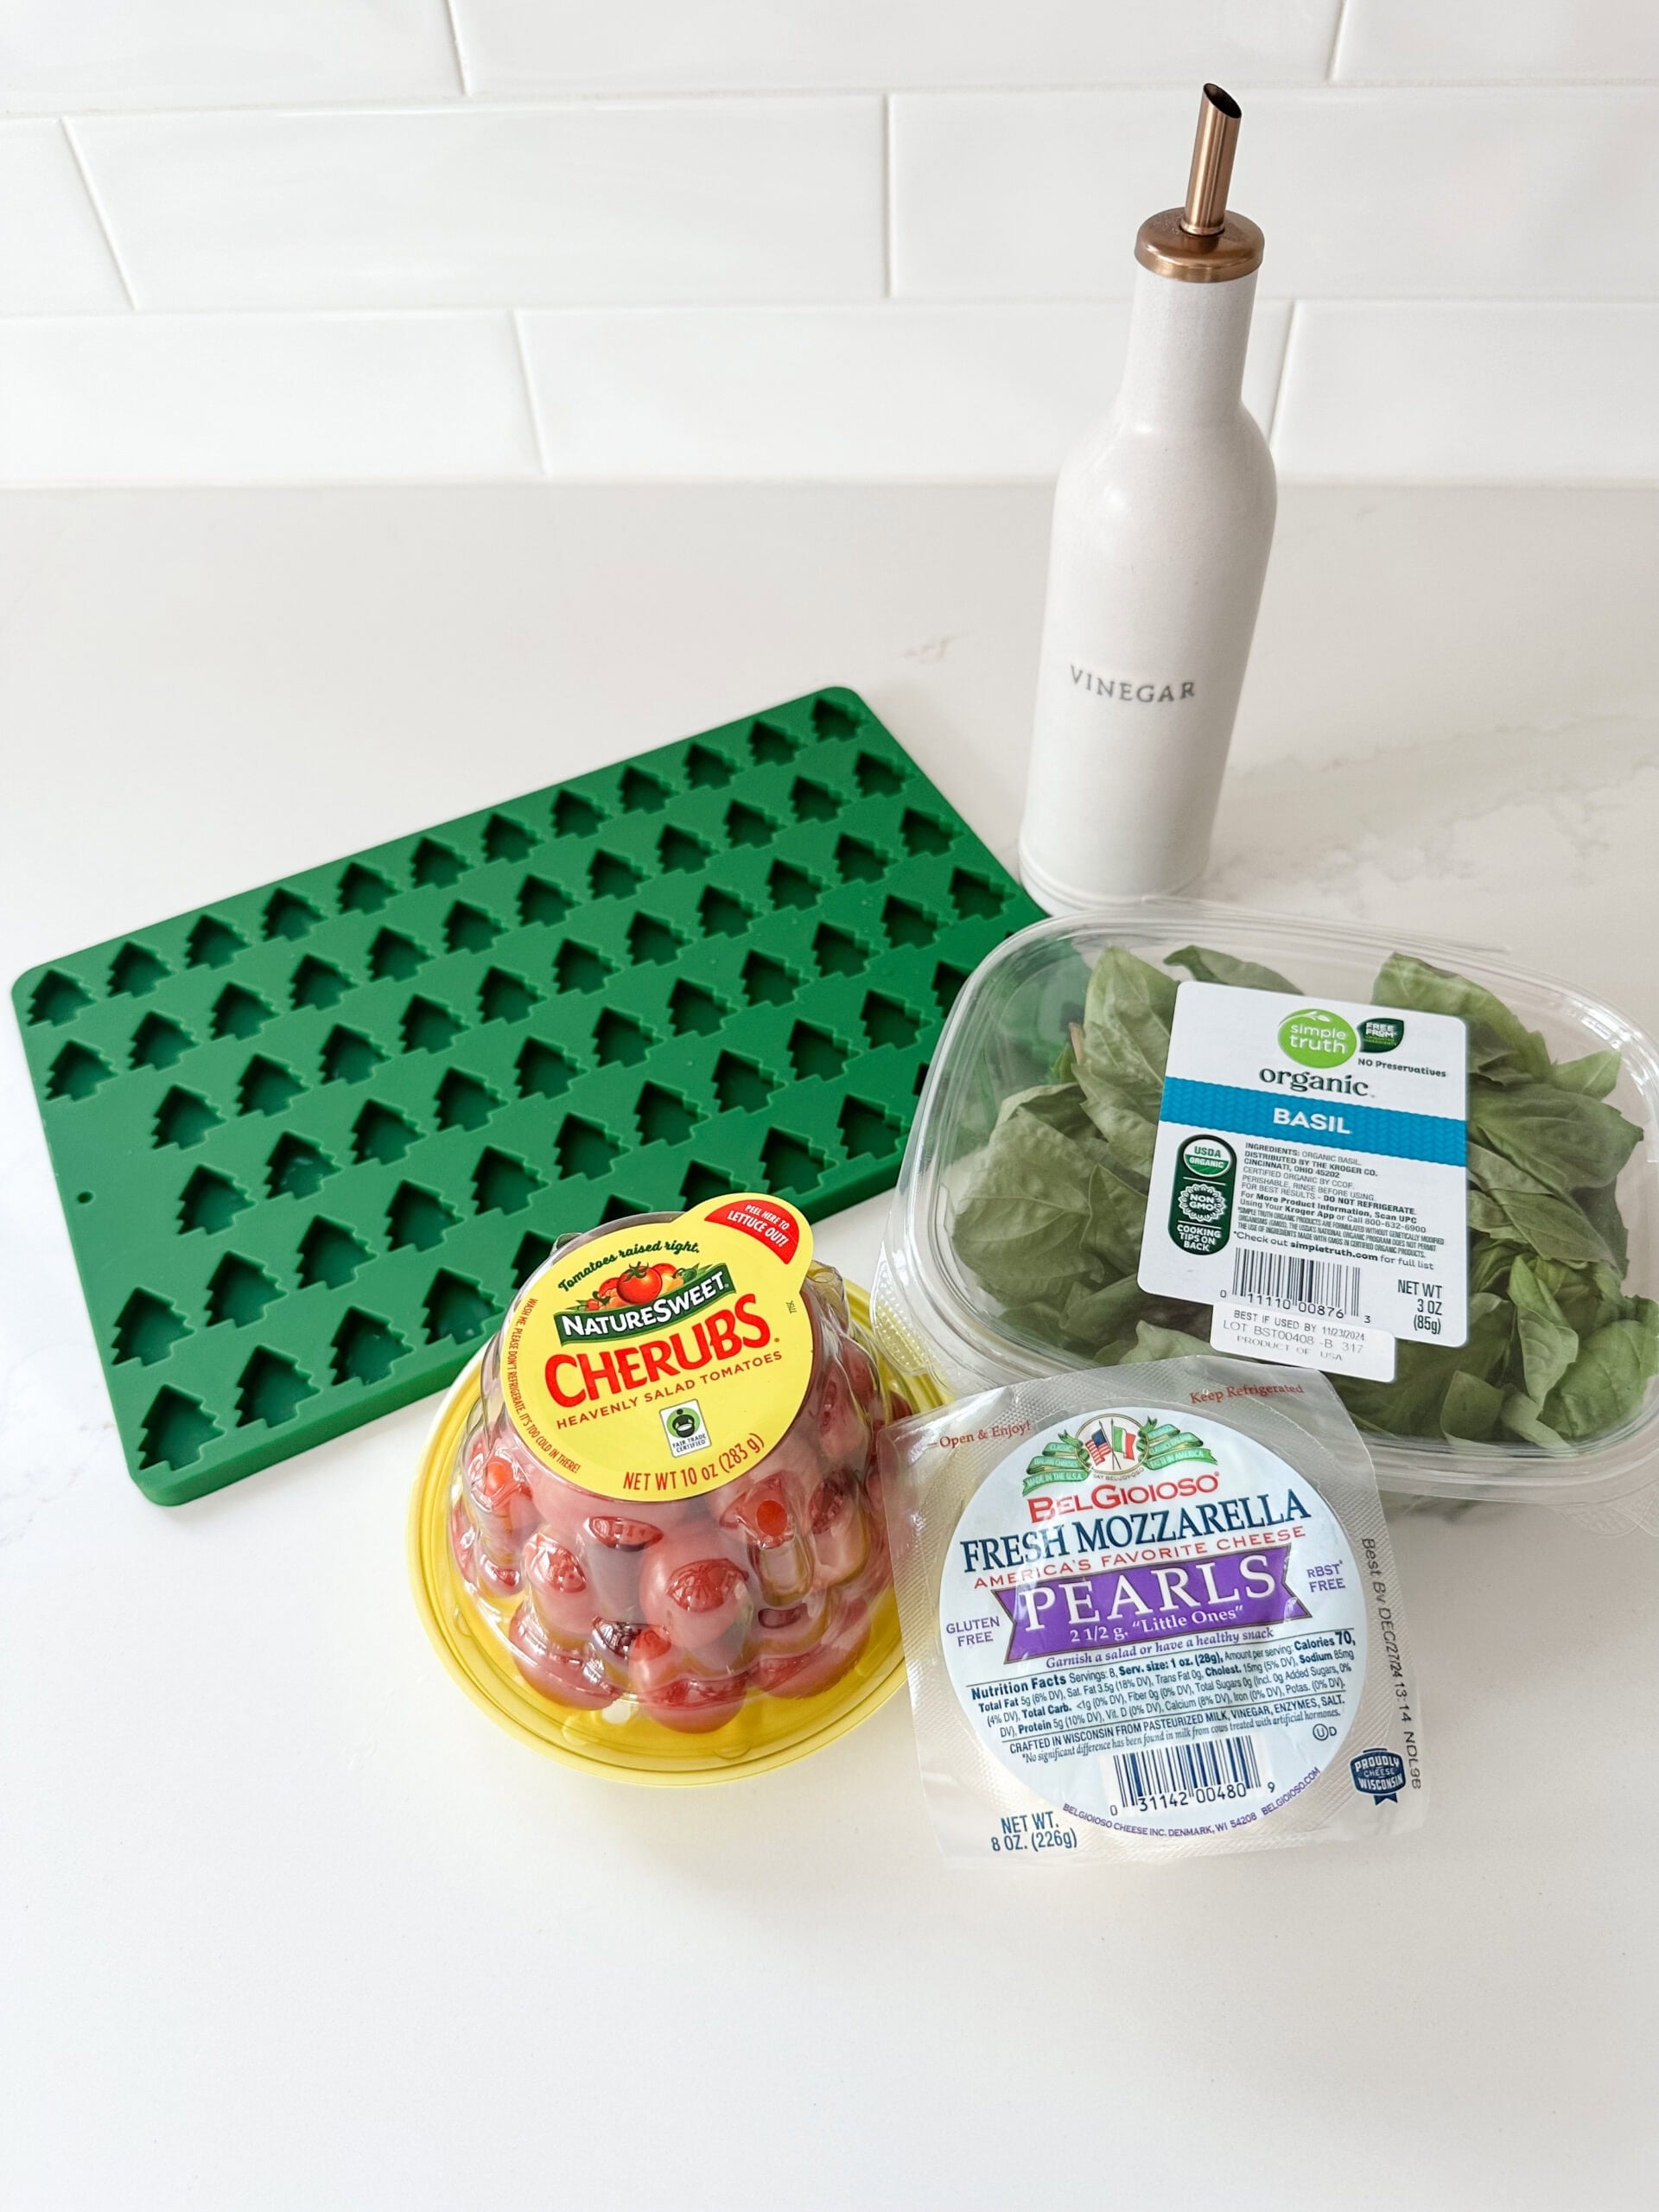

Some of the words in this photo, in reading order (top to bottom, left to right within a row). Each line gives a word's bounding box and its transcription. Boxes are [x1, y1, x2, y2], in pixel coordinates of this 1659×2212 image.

[1071, 664, 1195, 702] VINEGAR
[1291, 1024, 1346, 1039] simple
[1366, 1022, 1395, 1032] FREE
[1289, 1035, 1345, 1054] truth
[1376, 1060, 1446, 1077] Preservatives
[1259, 1069, 1369, 1096] organic
[1273, 1108, 1351, 1134] BASIL
[1189, 1157, 1224, 1168] ORGANIC
[1194, 1147, 1221, 1158] USDA
[1244, 1151, 1296, 1164] DISTRIBUTED
[1330, 1164, 1362, 1174] KROGER
[1244, 1158, 1291, 1172] CINCINNATI,
[1189, 1202, 1213, 1211] GMO
[1190, 1194, 1214, 1204] NON
[745, 1205, 762, 1215] PEEL
[761, 1211, 781, 1224] HERE
[779, 1220, 790, 1230] TO
[728, 1211, 767, 1232] LETTUCE
[765, 1227, 789, 1247] OUT!
[1178, 1224, 1221, 1238] COOKING
[1179, 1232, 1199, 1242] TIPS
[1184, 1241, 1210, 1251] BACK
[1290, 1241, 1378, 1261] simpletruth.com
[1380, 1255, 1395, 1263] for
[1399, 1258, 1414, 1267] full
[1418, 1261, 1434, 1270] list
[559, 1255, 618, 1291] Tomatoes
[619, 1242, 662, 1258] raised
[664, 1241, 700, 1255] right.
[1398, 1279, 1419, 1295] NET
[1422, 1283, 1442, 1299] WT
[521, 1298, 538, 1316] WASH
[1249, 1294, 1291, 1309] 11110
[1299, 1302, 1344, 1319] 00876
[1417, 1299, 1423, 1313] 3
[1427, 1300, 1442, 1315] OZ
[1234, 1310, 1257, 1322] BEST
[1262, 1315, 1269, 1324] IF
[1274, 1318, 1299, 1329] USED
[1305, 1324, 1316, 1332] BY
[1414, 1314, 1441, 1334] (85g)
[509, 1328, 523, 1350] PLEASE
[1224, 1320, 1247, 1332] LOT
[1342, 1342, 1363, 1353] 317
[544, 1294, 771, 1408] CHERUBS
[1237, 1336, 1289, 1351] PRODUCT
[1320, 1351, 1343, 1361] USA
[556, 1397, 638, 1429] HEAVENLY
[644, 1380, 696, 1402] SALAD
[700, 1351, 782, 1383] TOMATOES
[1190, 1390, 1223, 1404] Keep
[1226, 1384, 1304, 1398] Refrigerated
[526, 1424, 540, 1438] TOO
[672, 1440, 686, 1448] FAIR
[688, 1433, 706, 1443] TRADE
[939, 1432, 974, 1449] Open
[977, 1429, 988, 1440] &
[992, 1420, 1032, 1440] Enjoy!
[536, 1436, 552, 1452] COLD
[549, 1448, 560, 1459] IN
[676, 1440, 706, 1452] CERTIFIED
[556, 1454, 581, 1473] THERE!
[623, 1471, 651, 1491] NET
[656, 1471, 676, 1491] WT
[681, 1467, 697, 1486] 10
[719, 1443, 747, 1473] (283
[747, 1433, 765, 1453] g)
[960, 1523, 1070, 1573] FRESH
[1072, 1489, 1311, 1553] MOZZARELLA
[975, 1559, 1091, 1589] AMERICA'S
[1102, 1542, 1207, 1567] FAVORITE
[1217, 1526, 1306, 1550] CHEESE
[1019, 1554, 1275, 1631] PEARLS
[1309, 1578, 1345, 1592] FREE
[946, 1616, 1001, 1635] GLUTEN
[1070, 1630, 1080, 1642] 2
[1084, 1626, 1109, 1643] 1/2
[1362, 1538, 1382, 1575] Best
[1395, 1681, 1412, 1722] 13:14
[957, 1631, 994, 1647] FREE
[1046, 1652, 1092, 1669] Garnish
[1096, 1653, 1103, 1662] a
[1105, 1646, 1136, 1661] salad
[1140, 1645, 1154, 1655] or
[1156, 1639, 1183, 1652] have
[1185, 1637, 1193, 1647] a
[1196, 1630, 1239, 1645] healthy
[1243, 1627, 1274, 1639] snack
[971, 1682, 1029, 1700] Nutrition
[1032, 1675, 1066, 1689] Facts
[1070, 1671, 1108, 1683] Servings:
[1119, 1664, 1145, 1675] Serv.
[1147, 1661, 1169, 1670] size:
[1171, 1659, 1175, 1668] 1
[1179, 1658, 1194, 1668] oz.
[1225, 1650, 1252, 1660] Amount
[1253, 1649, 1263, 1659] per
[1265, 1645, 1293, 1658] serving:
[1294, 1637, 1334, 1650] Calories
[1335, 1631, 1356, 1646] 70,
[1010, 1738, 1050, 1753] CRAFTED
[1052, 1735, 1062, 1745] IN
[1064, 1726, 1114, 1744] WISCONSIN
[1116, 1723, 1141, 1735] FROM
[1143, 1716, 1204, 1732] PASTEURIZED
[1206, 1710, 1228, 1722] MILK,
[1231, 1706, 1273, 1719] VINEGAR,
[1275, 1700, 1320, 1713] ENZYMES,
[1321, 1694, 1345, 1706] SALT.
[1354, 1756, 1400, 1772] PROUDLY
[1363, 1768, 1395, 1777] CHEESE
[1358, 1773, 1403, 1790] WISCONSIN
[1063, 1803, 1112, 1828] BELGIOIOSO
[1114, 1822, 1148, 1836] CHEESE
[1168, 1825, 1215, 1837] DENMARK,
[1215, 1822, 1228, 1832] WI
[1230, 1812, 1257, 1828] 54208
[1261, 1766, 1321, 1815] BELGIOIOSO.COM
[1110, 1805, 1118, 1816] 0
[1138, 1791, 1189, 1812] 31142
[1196, 1783, 1246, 1803] 00480
[1268, 1782, 1275, 1793] 9
[1001, 1815, 1027, 1834] NET
[1033, 1811, 1058, 1829] WT.
[991, 1837, 1000, 1852] 8
[1004, 1834, 1027, 1850] OZ.
[1032, 1827, 1077, 1852] (226g)
